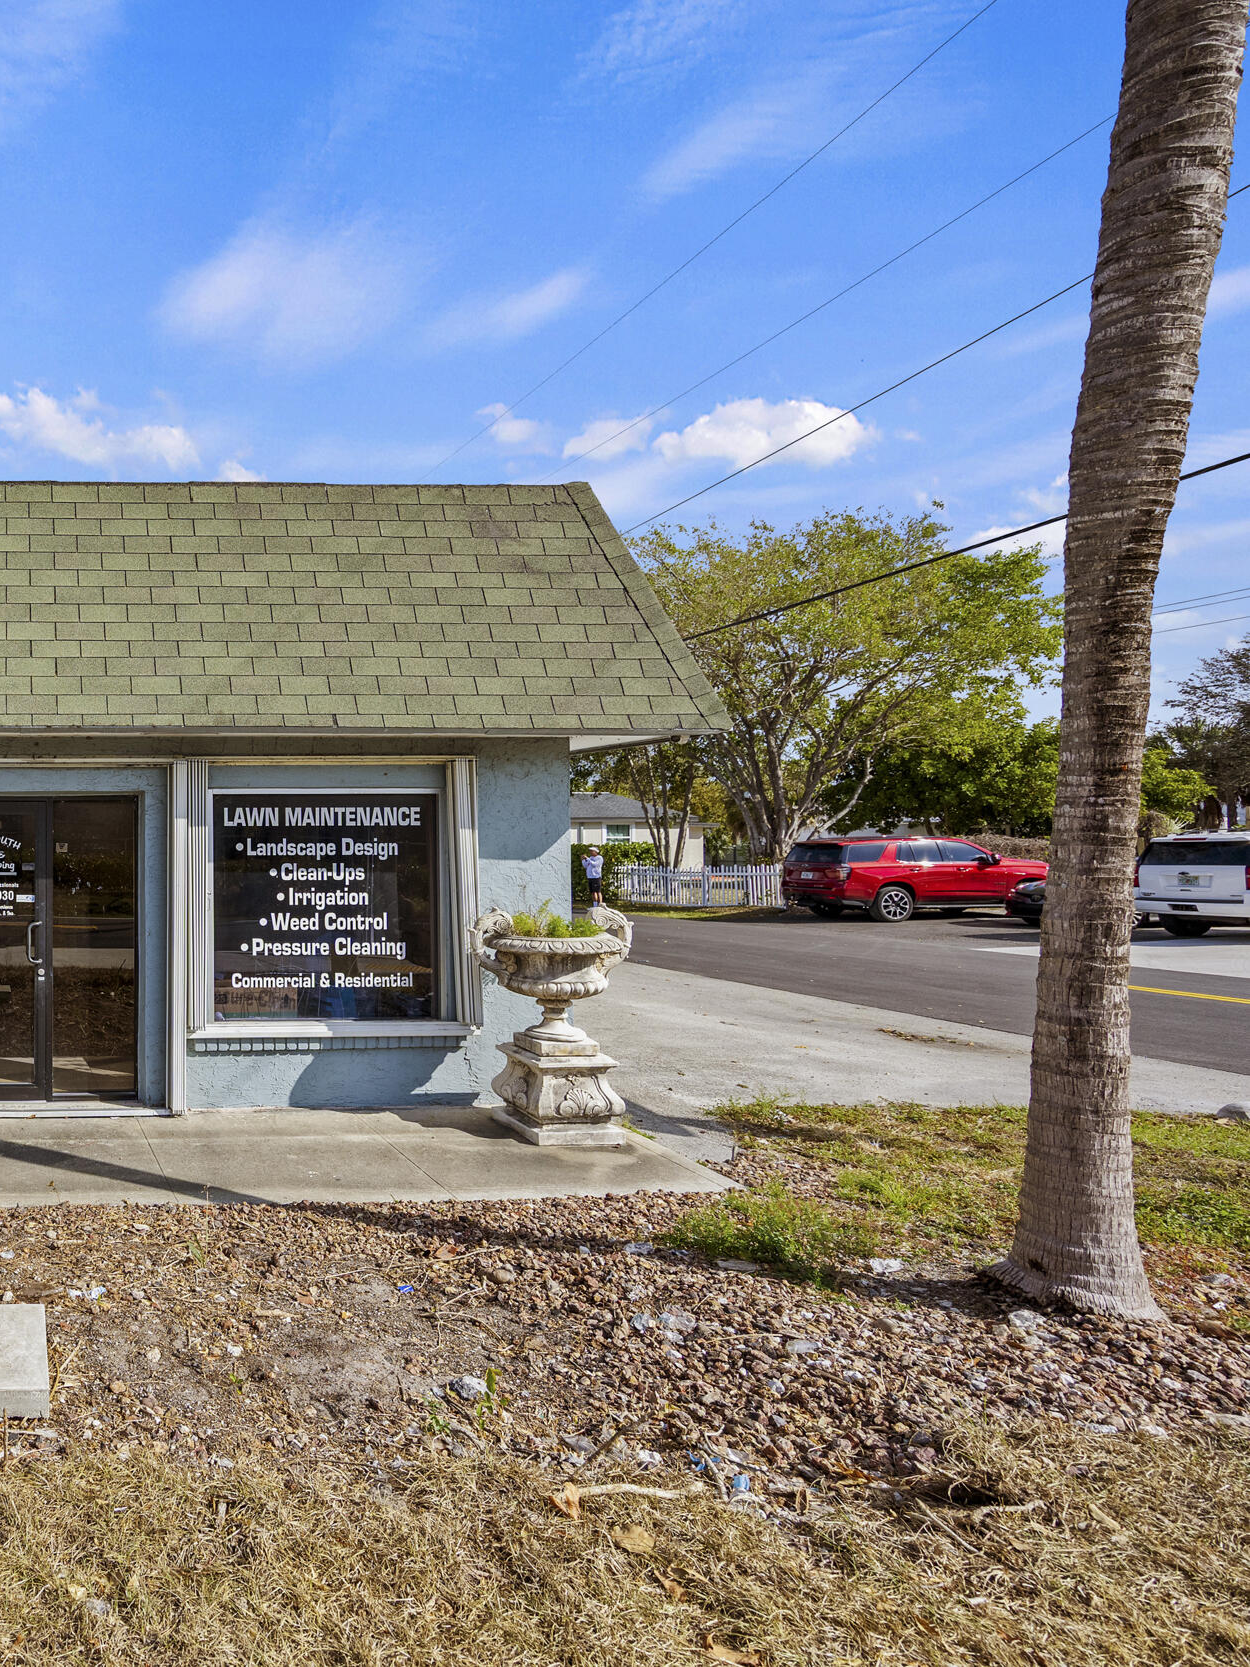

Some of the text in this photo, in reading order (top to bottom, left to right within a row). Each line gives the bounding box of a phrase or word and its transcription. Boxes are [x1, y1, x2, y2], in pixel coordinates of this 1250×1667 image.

[223, 806, 421, 827] LAWN MAINTENANCE
[246, 837, 399, 861] Landscape Design
[280, 862, 366, 885] Clean-Ups
[288, 886, 371, 910] Irrigation
[270, 911, 388, 931] Weed Control
[251, 936, 406, 960] Pressure Cleaning
[231, 971, 413, 989] Commercial & Residential
